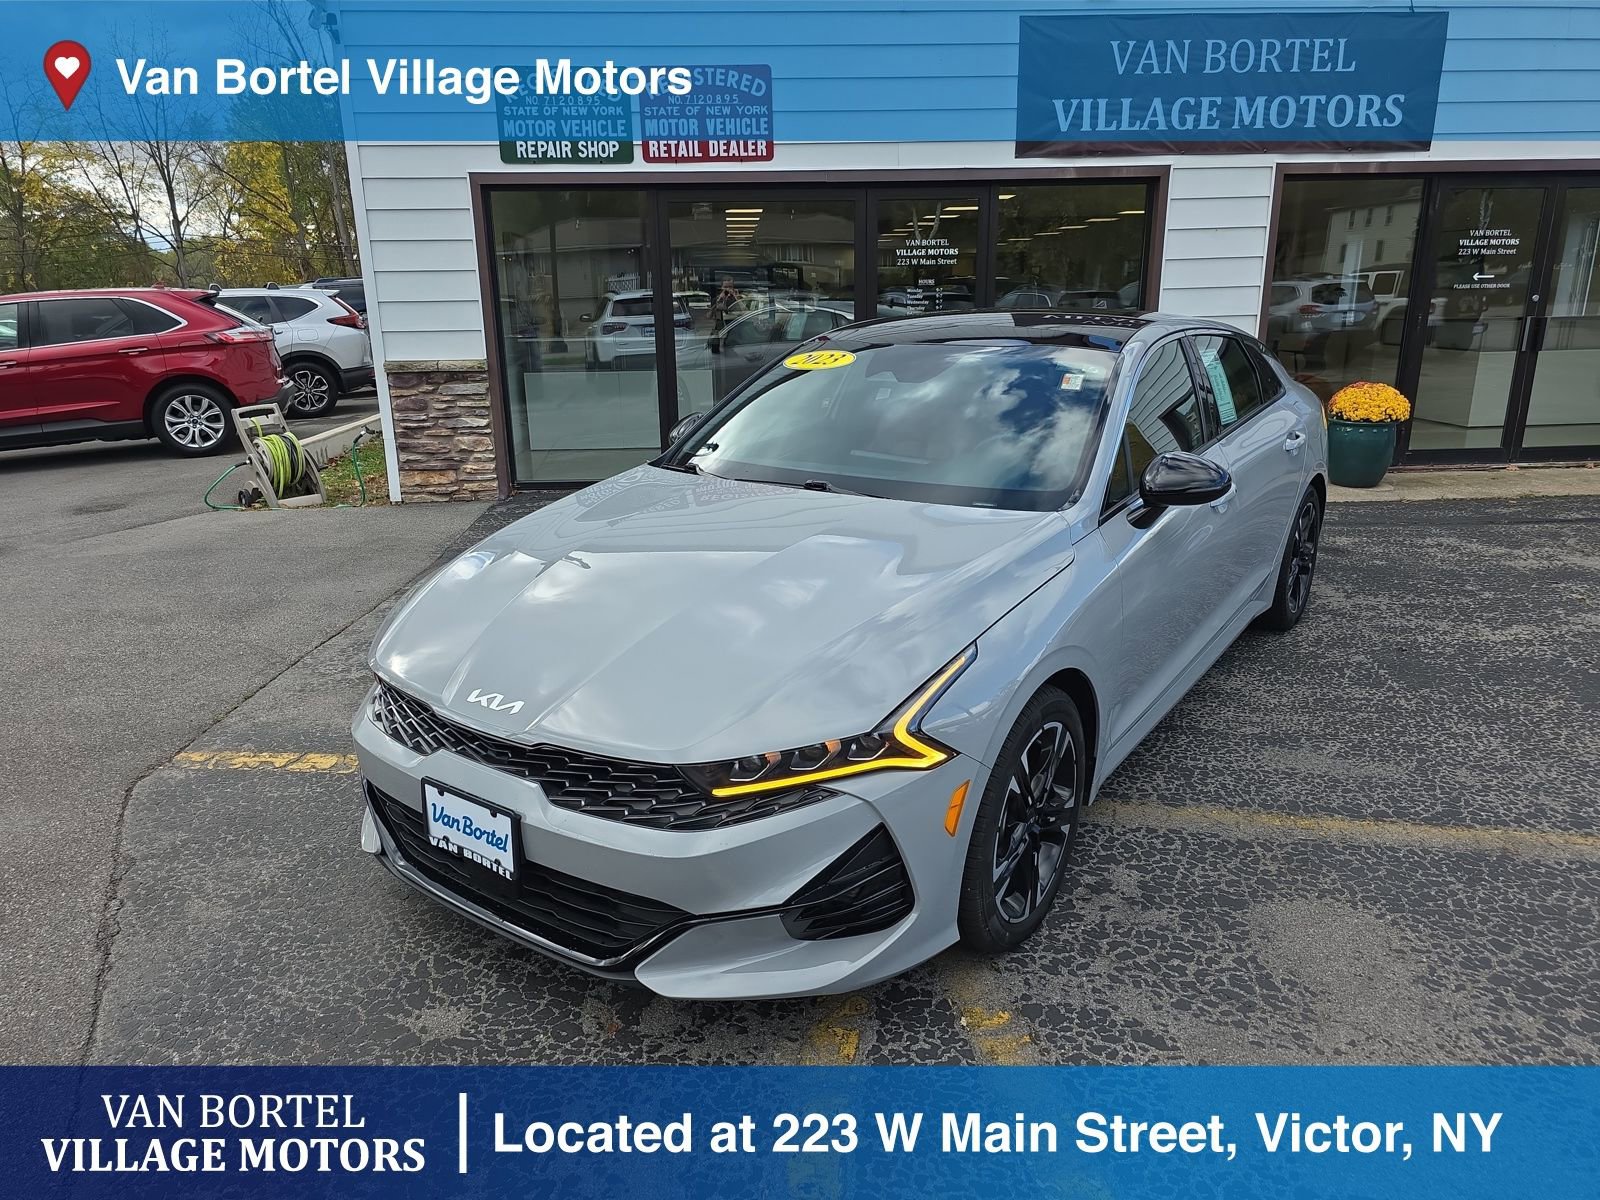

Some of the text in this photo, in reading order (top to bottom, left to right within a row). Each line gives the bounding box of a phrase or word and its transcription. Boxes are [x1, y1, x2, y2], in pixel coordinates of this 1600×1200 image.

[1110, 38, 1357, 75] VAN BORTEL
[544, 95, 601, 105] 7120895
[686, 94, 739, 104] 7120895
[503, 106, 624, 116] STATE OF NEW YORK
[644, 105, 769, 116] STATE OF NEW YORK
[1052, 93, 1406, 132] VILLAGE MOTORS
[503, 119, 627, 137] MOTOR VEHICLE
[645, 117, 769, 137] MOTOR VEHICLE
[516, 140, 620, 158] REPAIR SHOP
[649, 139, 767, 158] RETAIL DEALER
[791, 354, 847, 365] 2023
[467, 688, 525, 715] KIA
[428, 836, 513, 881] VAN BORTEL
